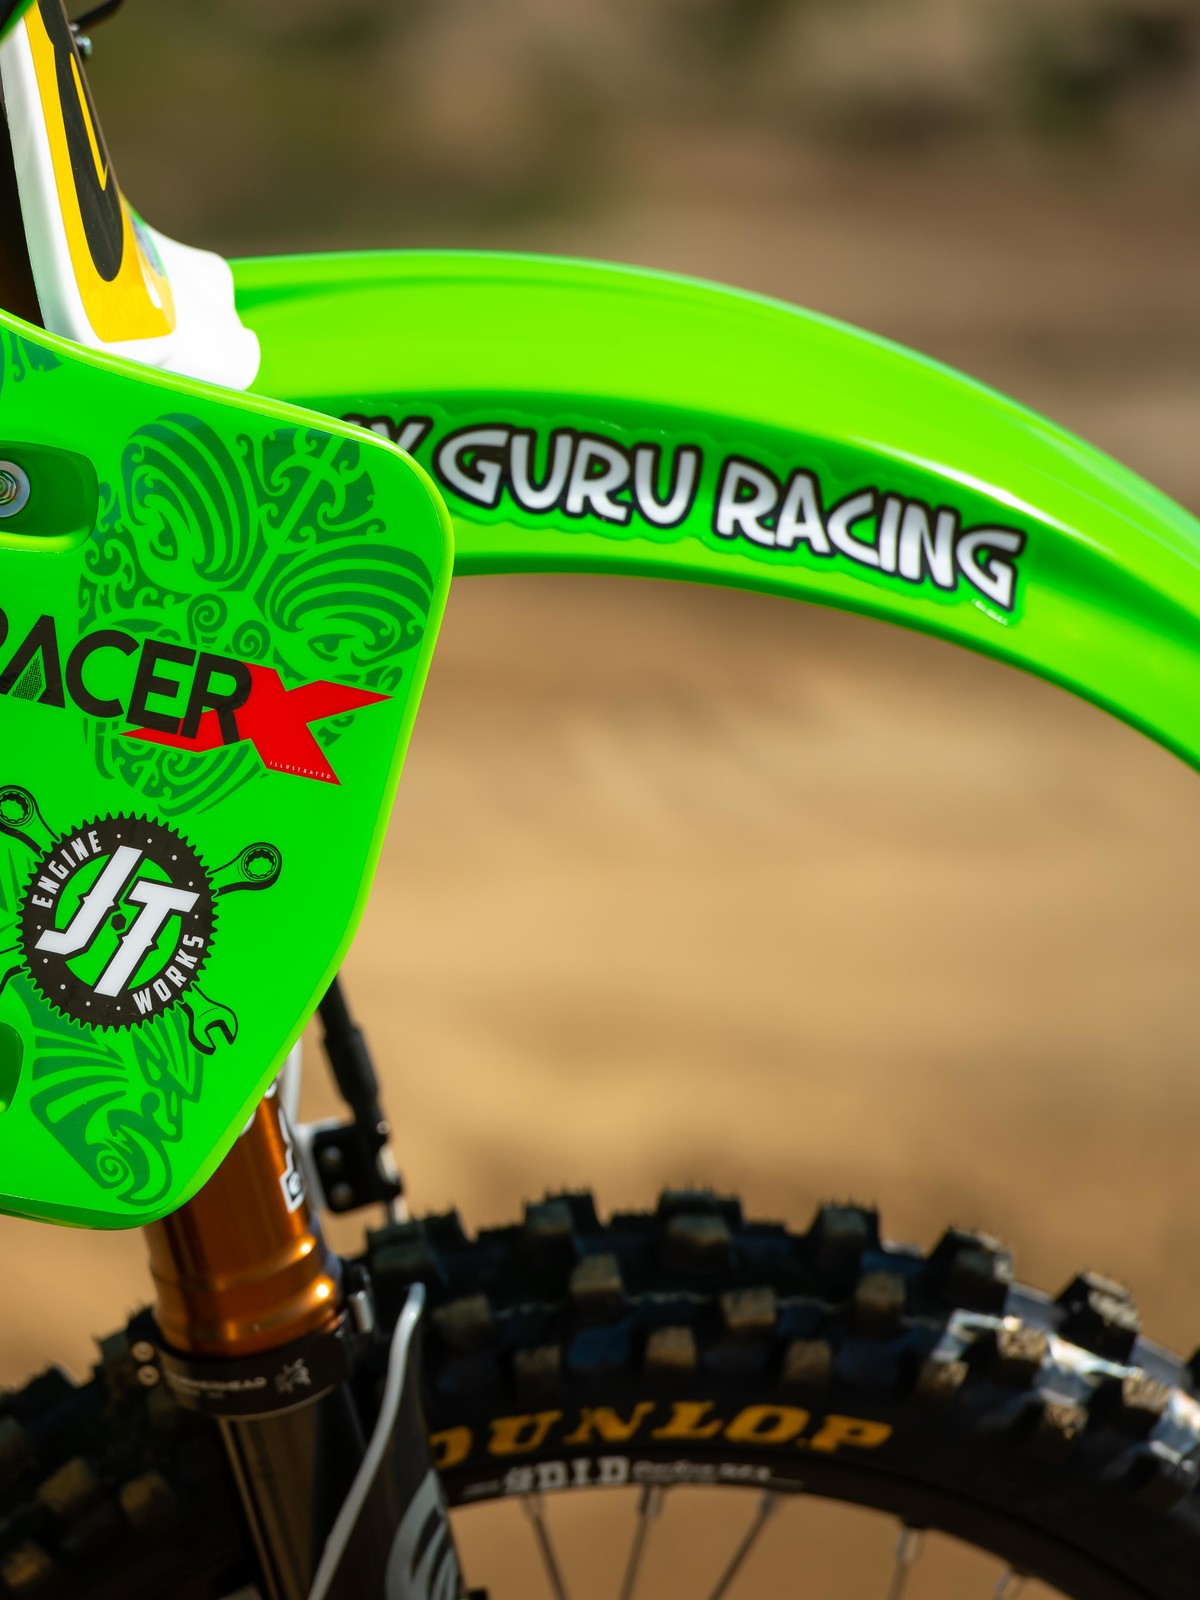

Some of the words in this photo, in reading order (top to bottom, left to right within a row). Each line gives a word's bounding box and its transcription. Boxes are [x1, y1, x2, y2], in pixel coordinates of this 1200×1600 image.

[433, 424, 701, 528] GURU
[713, 456, 1026, 612] RACING
[269, 760, 332, 779] ILLUSTRATED
[31, 829, 103, 909] ENGINE
[132, 933, 205, 1015] WORKS
